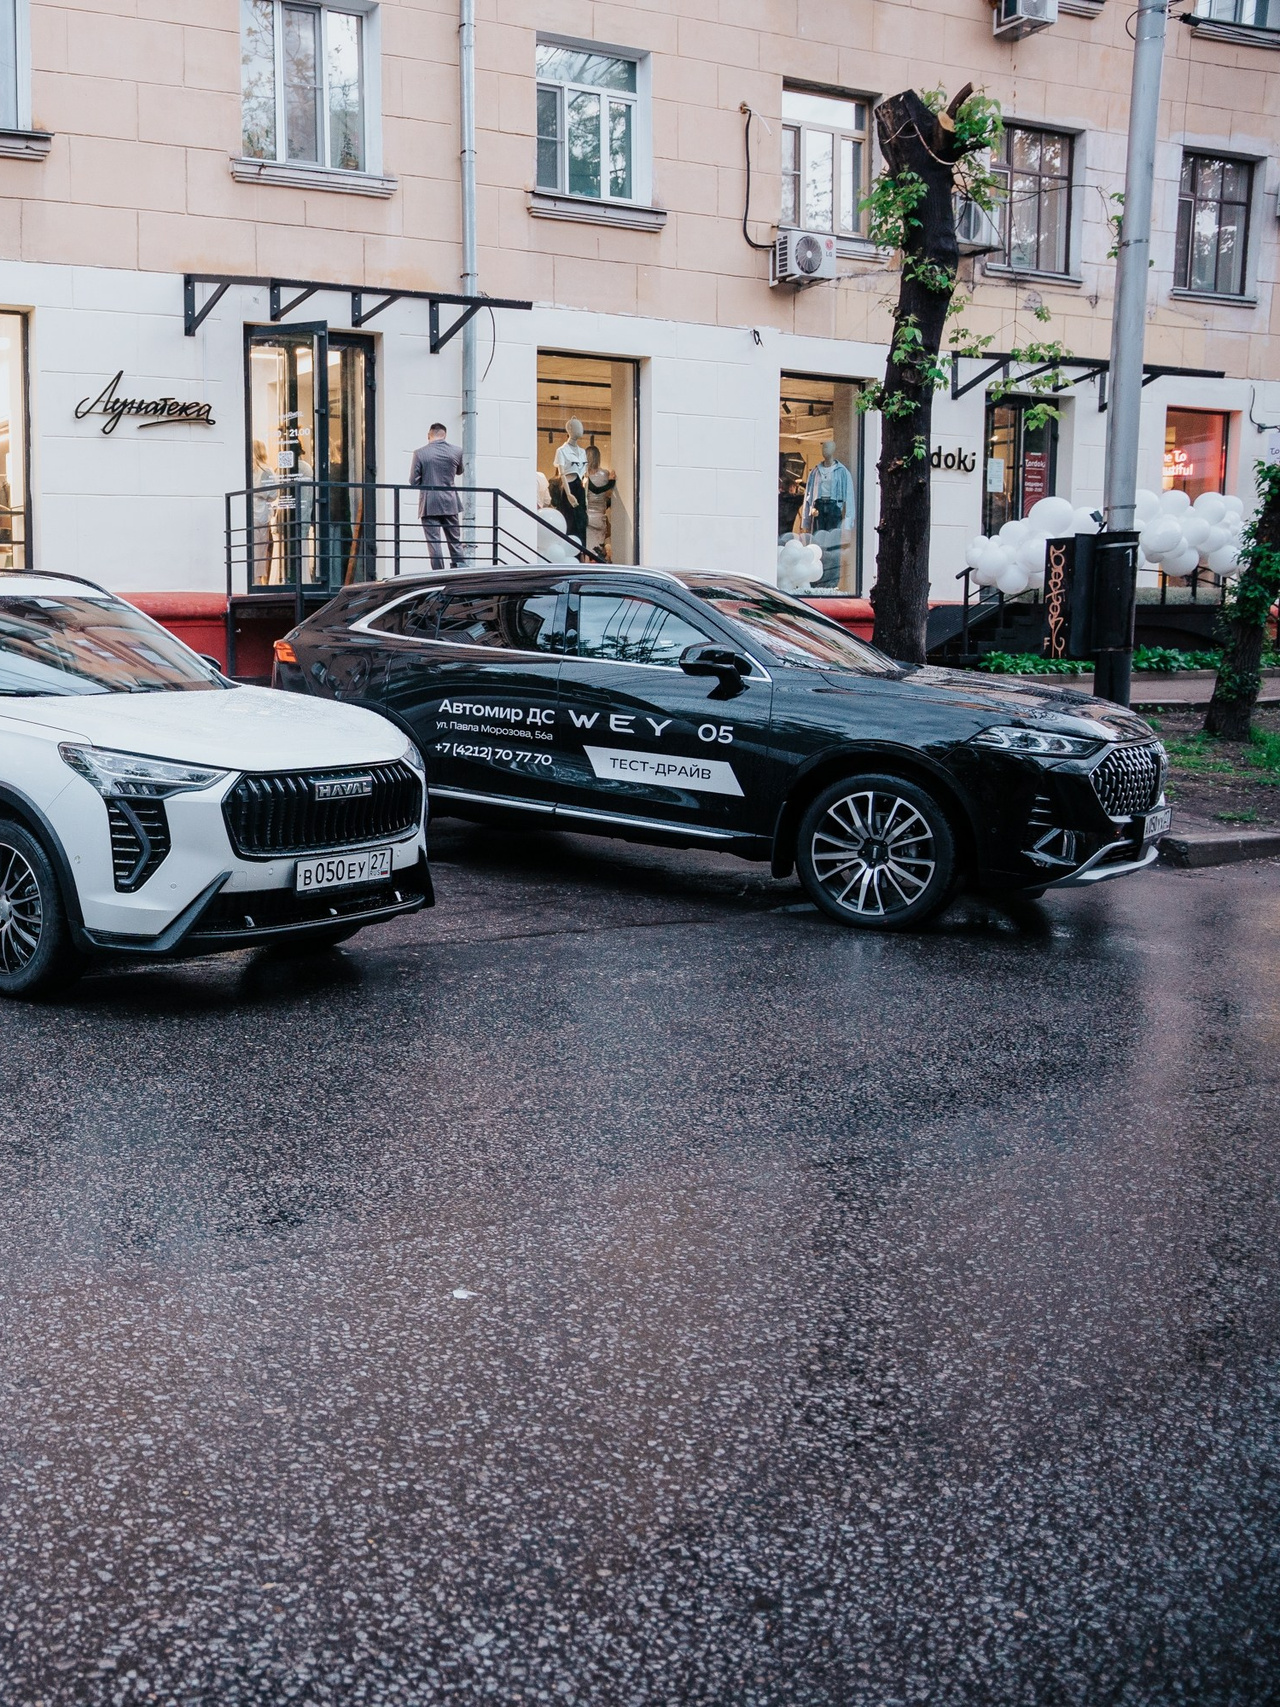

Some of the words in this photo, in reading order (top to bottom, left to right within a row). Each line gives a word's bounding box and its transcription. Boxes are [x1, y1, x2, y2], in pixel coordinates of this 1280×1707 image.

[930, 445, 977, 472] doki
[438, 699, 523, 723] Автомир
[526, 708, 556, 726] ДС
[450, 721, 479, 732] Павла
[480, 724, 534, 739] Морозова,
[535, 731, 553, 740] 56а
[568, 709, 673, 737] WEY
[697, 723, 734, 744] 05
[435, 743, 451, 753] +7
[494, 749, 513, 760] 70
[515, 751, 532, 763] 77
[533, 753, 553, 766] 70
[609, 757, 712, 780] ТЕСТ-ДРАЙВ
[319, 782, 372, 797] HAVAL
[371, 852, 386, 870] 27
